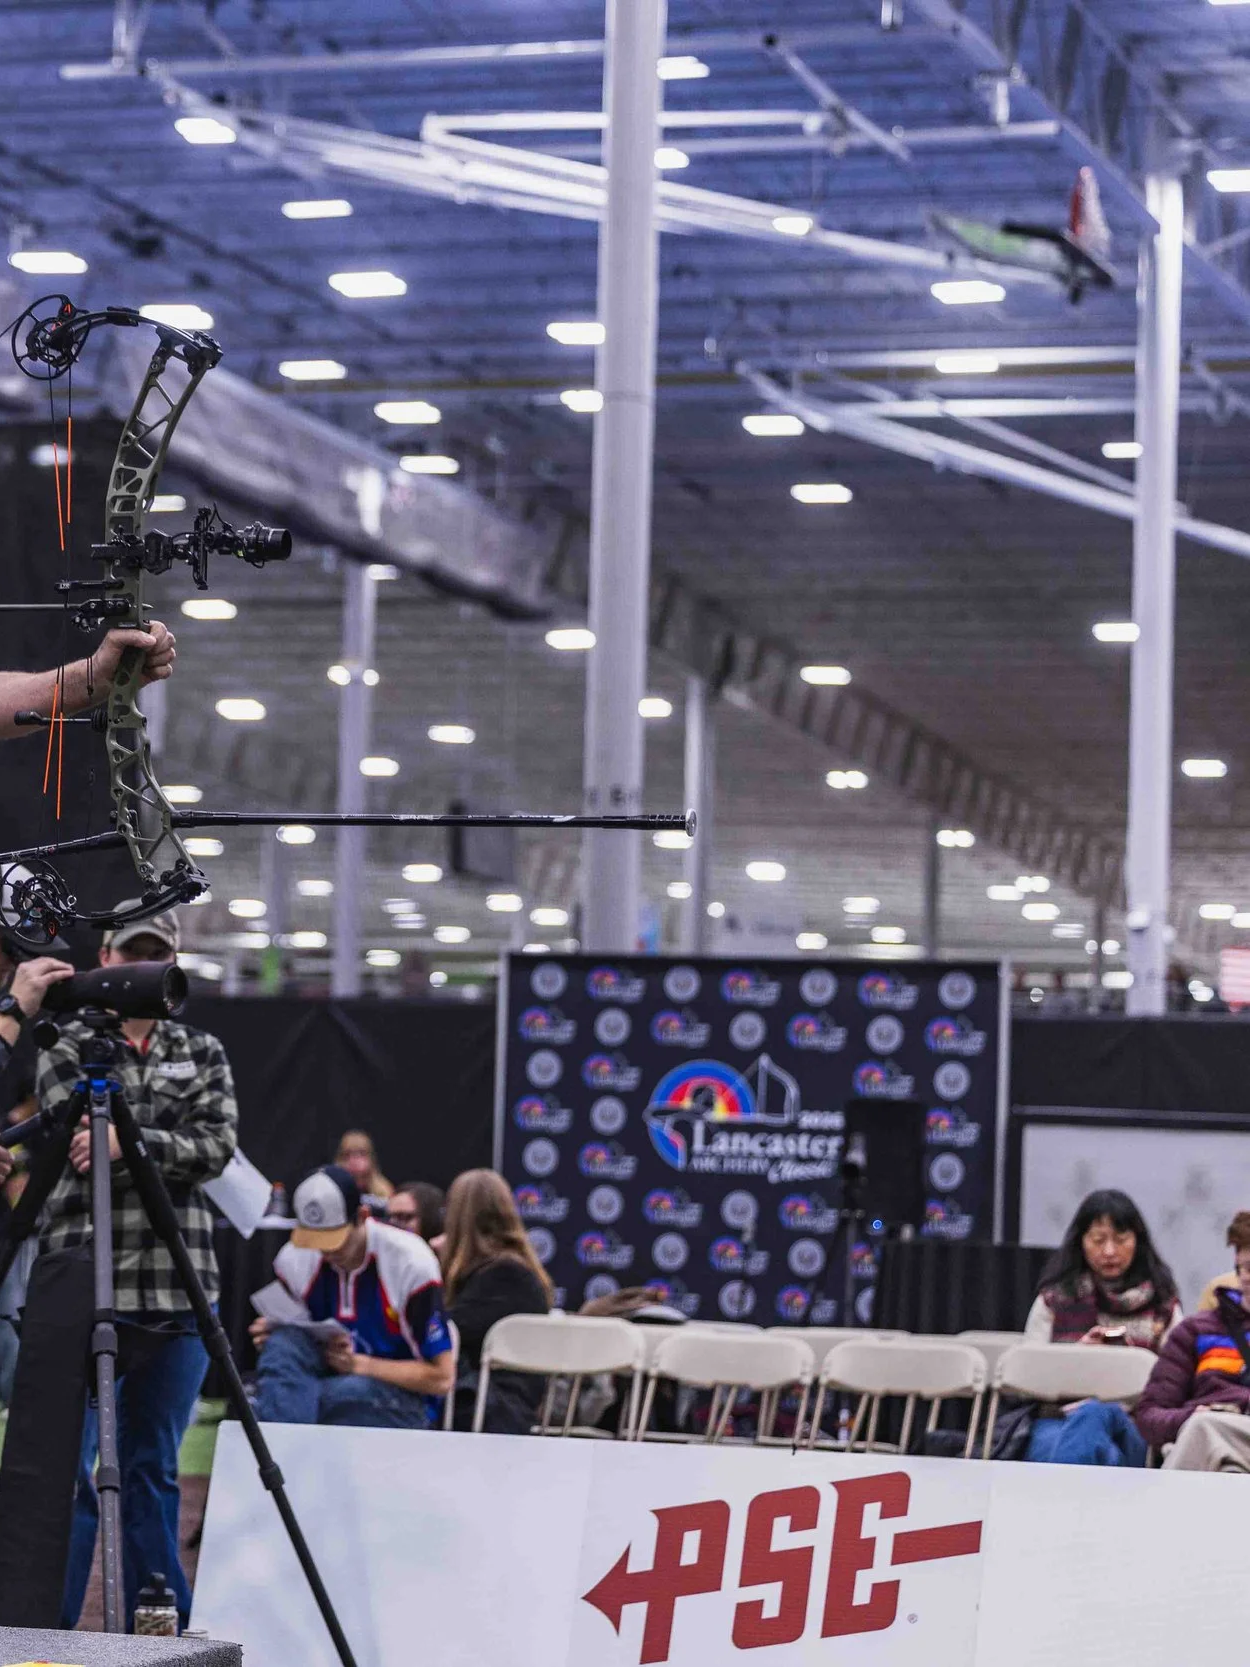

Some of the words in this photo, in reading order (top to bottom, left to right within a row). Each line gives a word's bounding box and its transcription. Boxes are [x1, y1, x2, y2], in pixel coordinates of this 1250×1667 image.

[692, 1119, 844, 1159] Lancaster
[691, 1157, 770, 1174] ARCHERY
[639, 1471, 911, 1665] PSE
